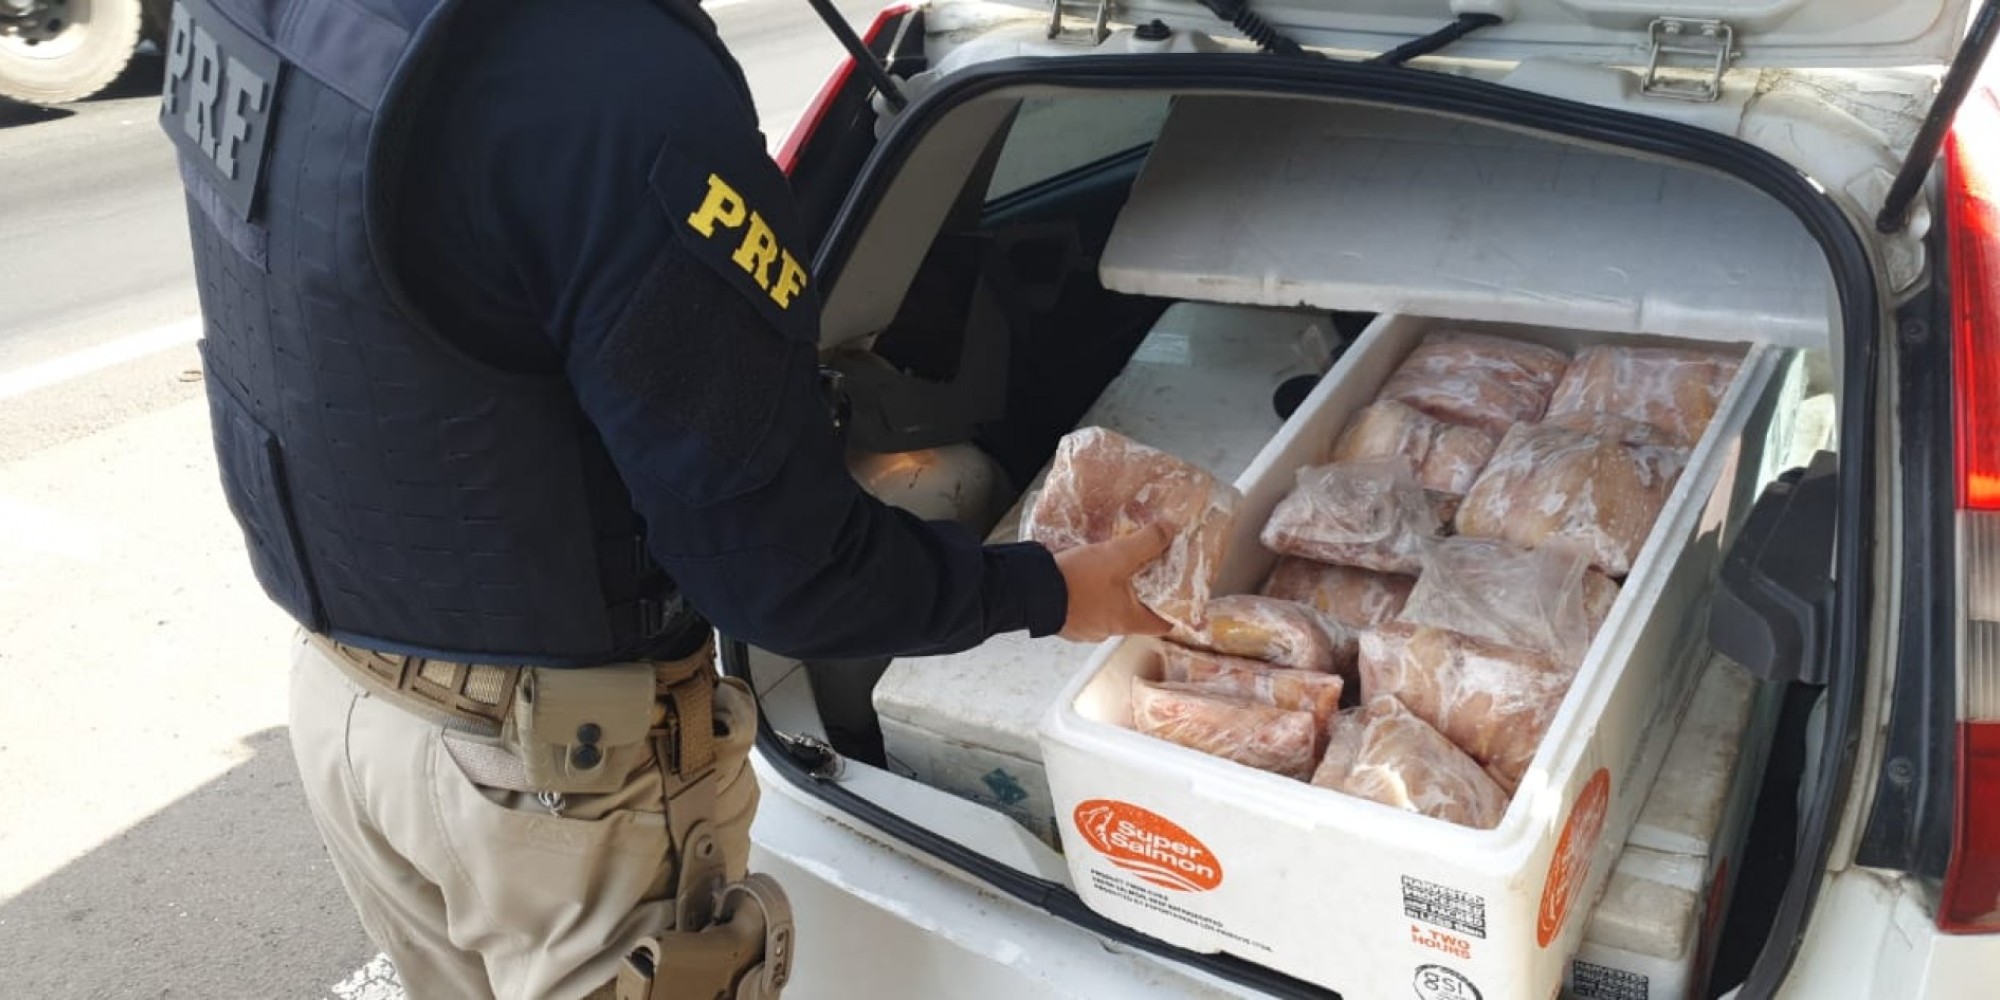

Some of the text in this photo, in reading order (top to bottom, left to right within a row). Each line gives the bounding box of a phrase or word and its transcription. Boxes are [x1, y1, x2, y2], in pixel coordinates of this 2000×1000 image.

[162, 0, 266, 180] PRF
[687, 173, 808, 310] PRF
[1111, 831, 1215, 879] Salmon
[1117, 819, 1203, 858] Super
[1412, 933, 1471, 960] HOURS
[1428, 929, 1470, 950] TWO
